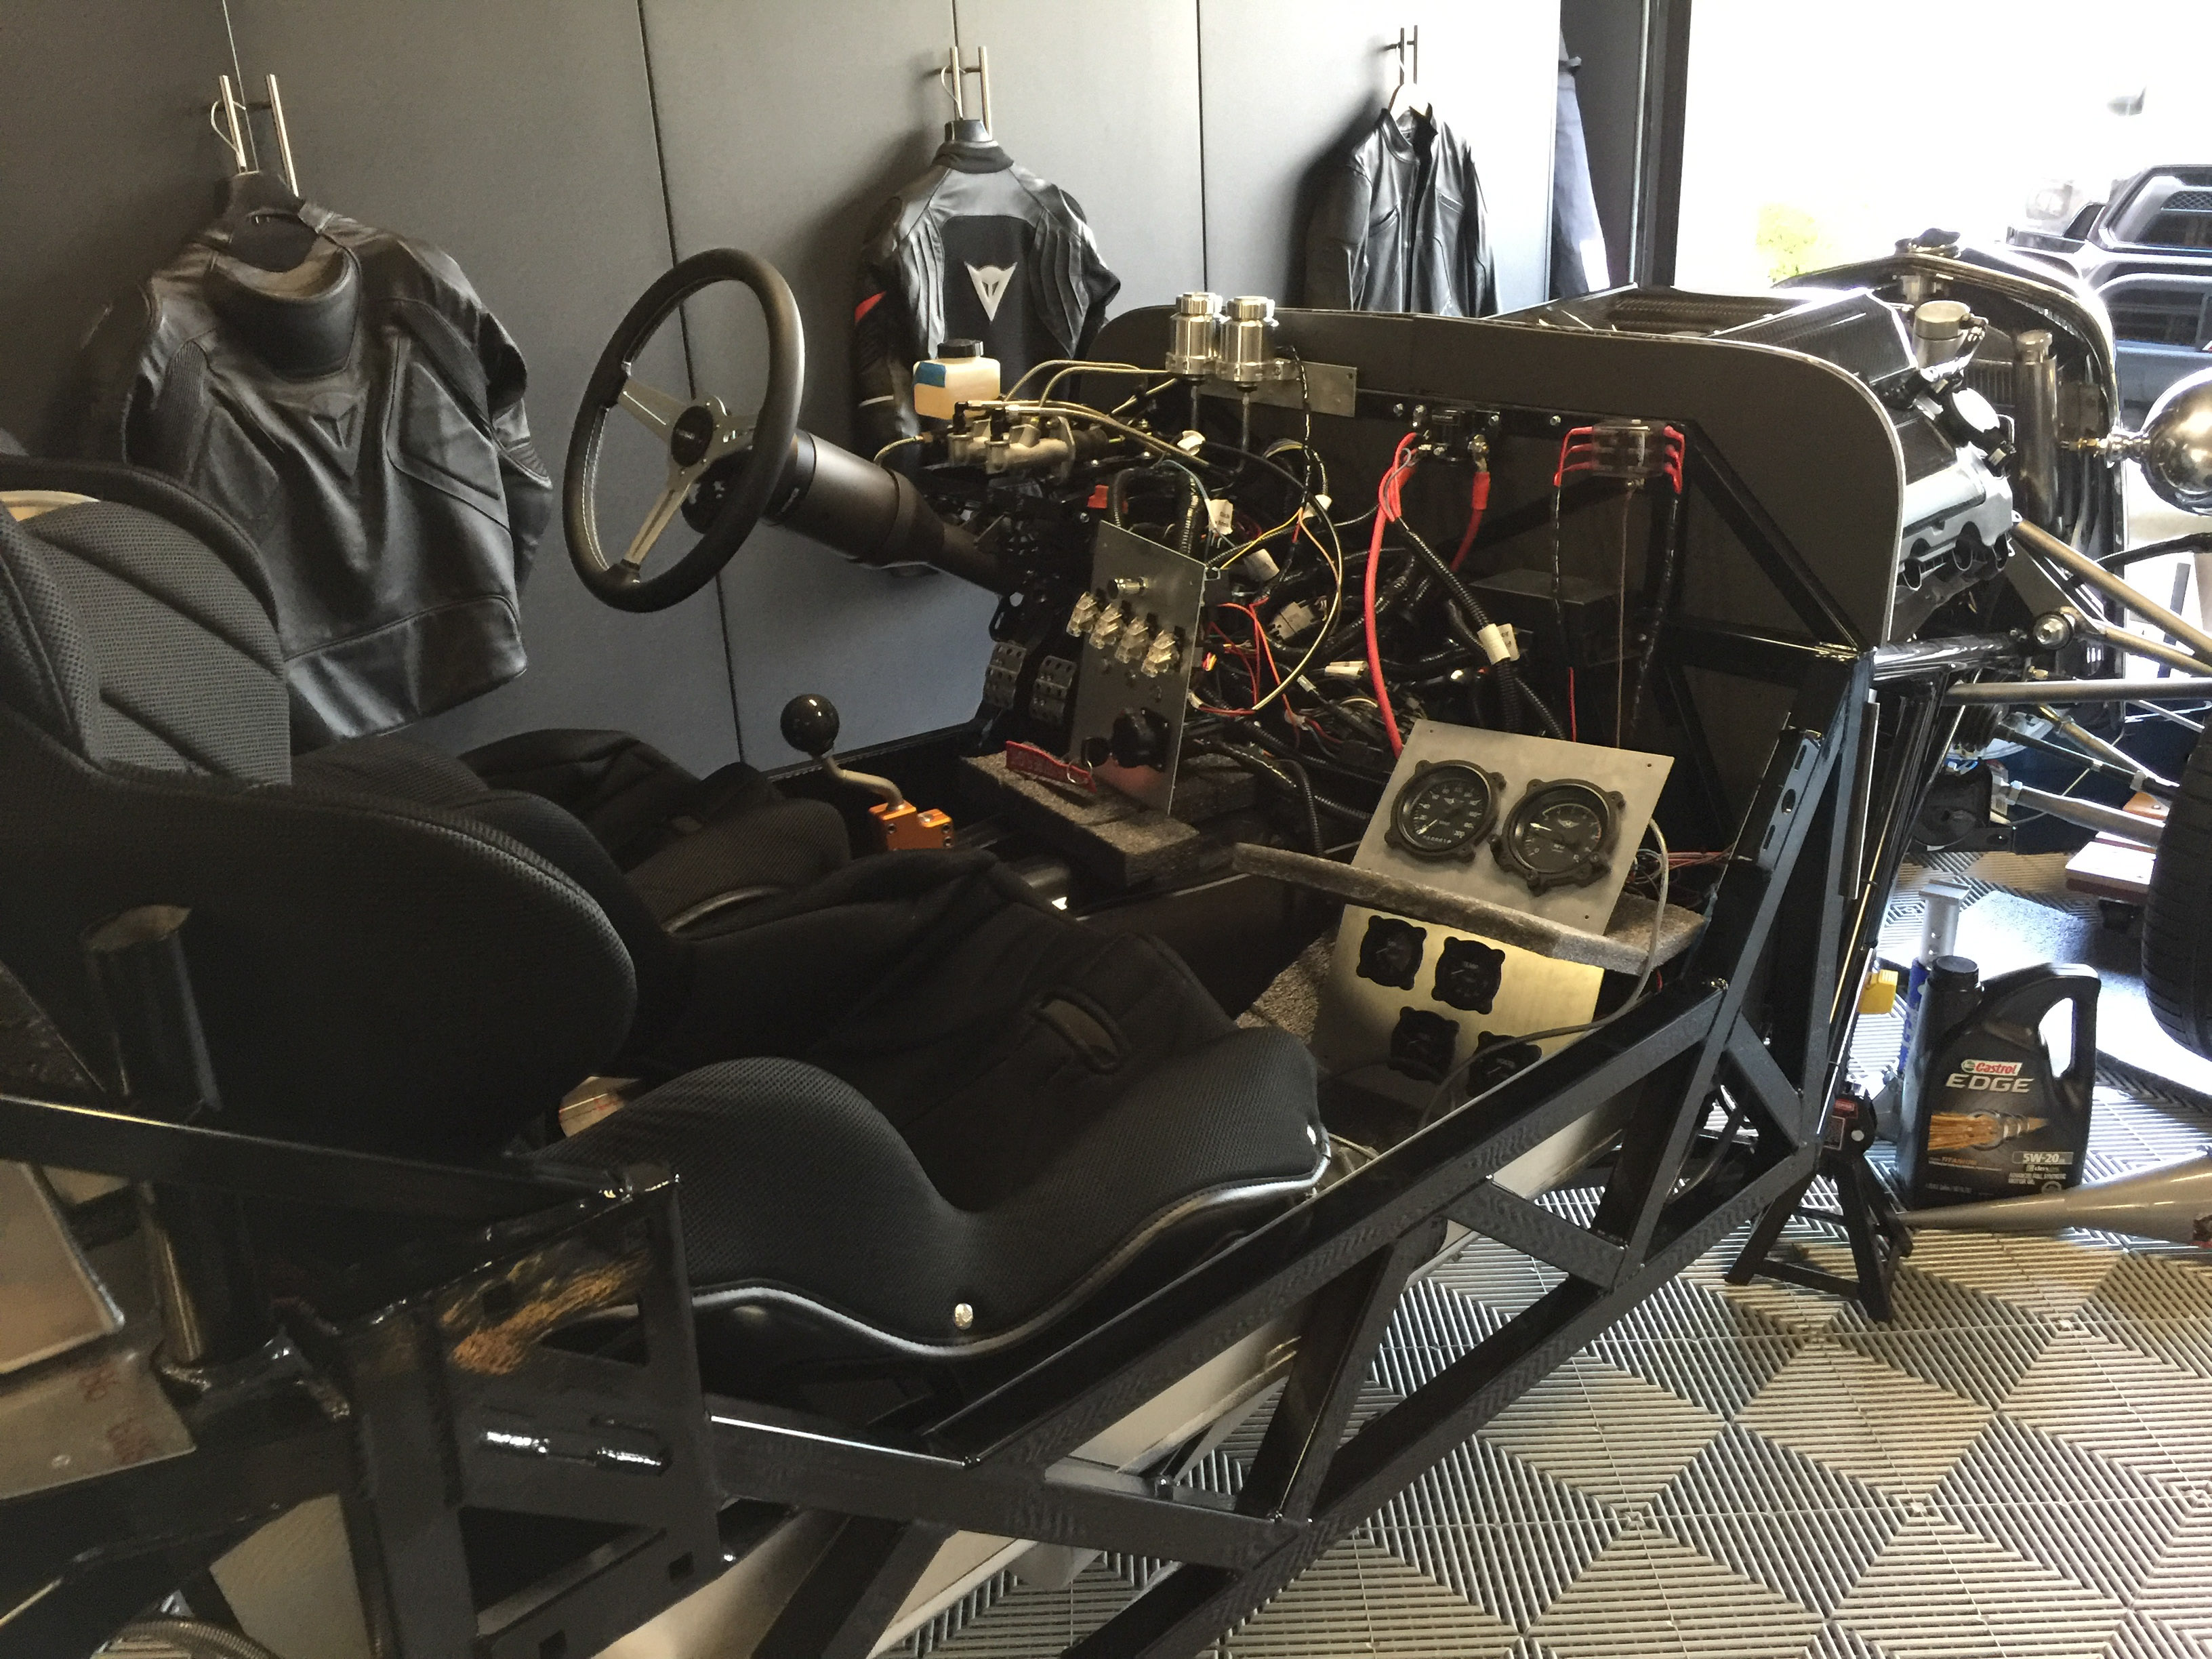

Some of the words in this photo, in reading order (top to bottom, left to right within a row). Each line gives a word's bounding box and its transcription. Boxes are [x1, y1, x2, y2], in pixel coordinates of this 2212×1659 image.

[1975, 1062, 2017, 1074] Castrol
[1946, 1073, 2034, 1092] EDGE
[2022, 1153, 2060, 1163] 5W-20
